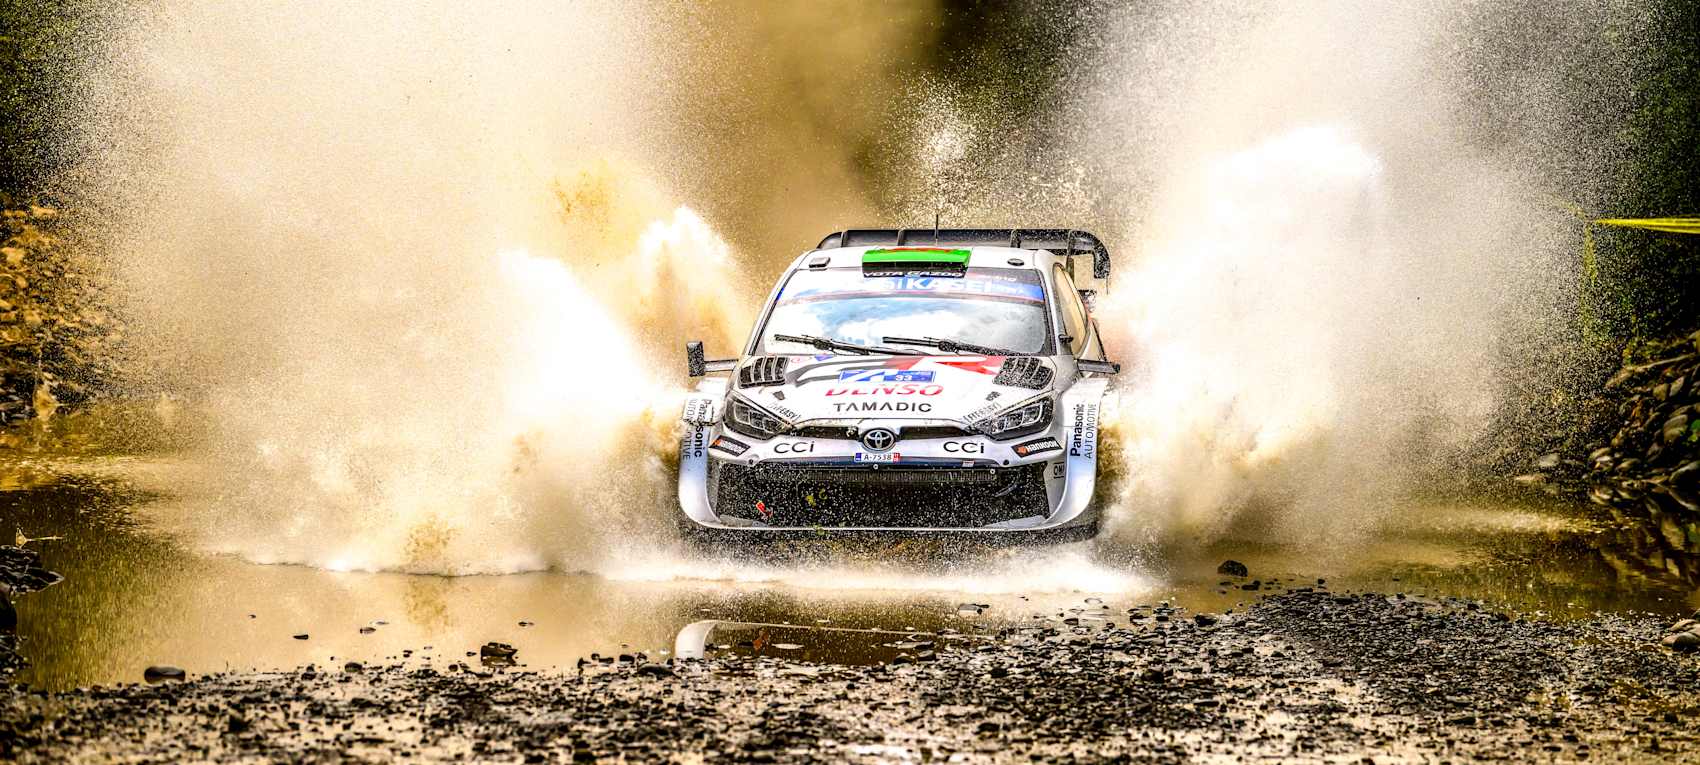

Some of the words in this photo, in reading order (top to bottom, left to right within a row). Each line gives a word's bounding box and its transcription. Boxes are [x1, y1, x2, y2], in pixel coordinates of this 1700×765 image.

[833, 402, 932, 412] TAMADIC
[1070, 404, 1084, 457] Panasonic
[1084, 403, 1097, 459] AUTOMOTIVE
